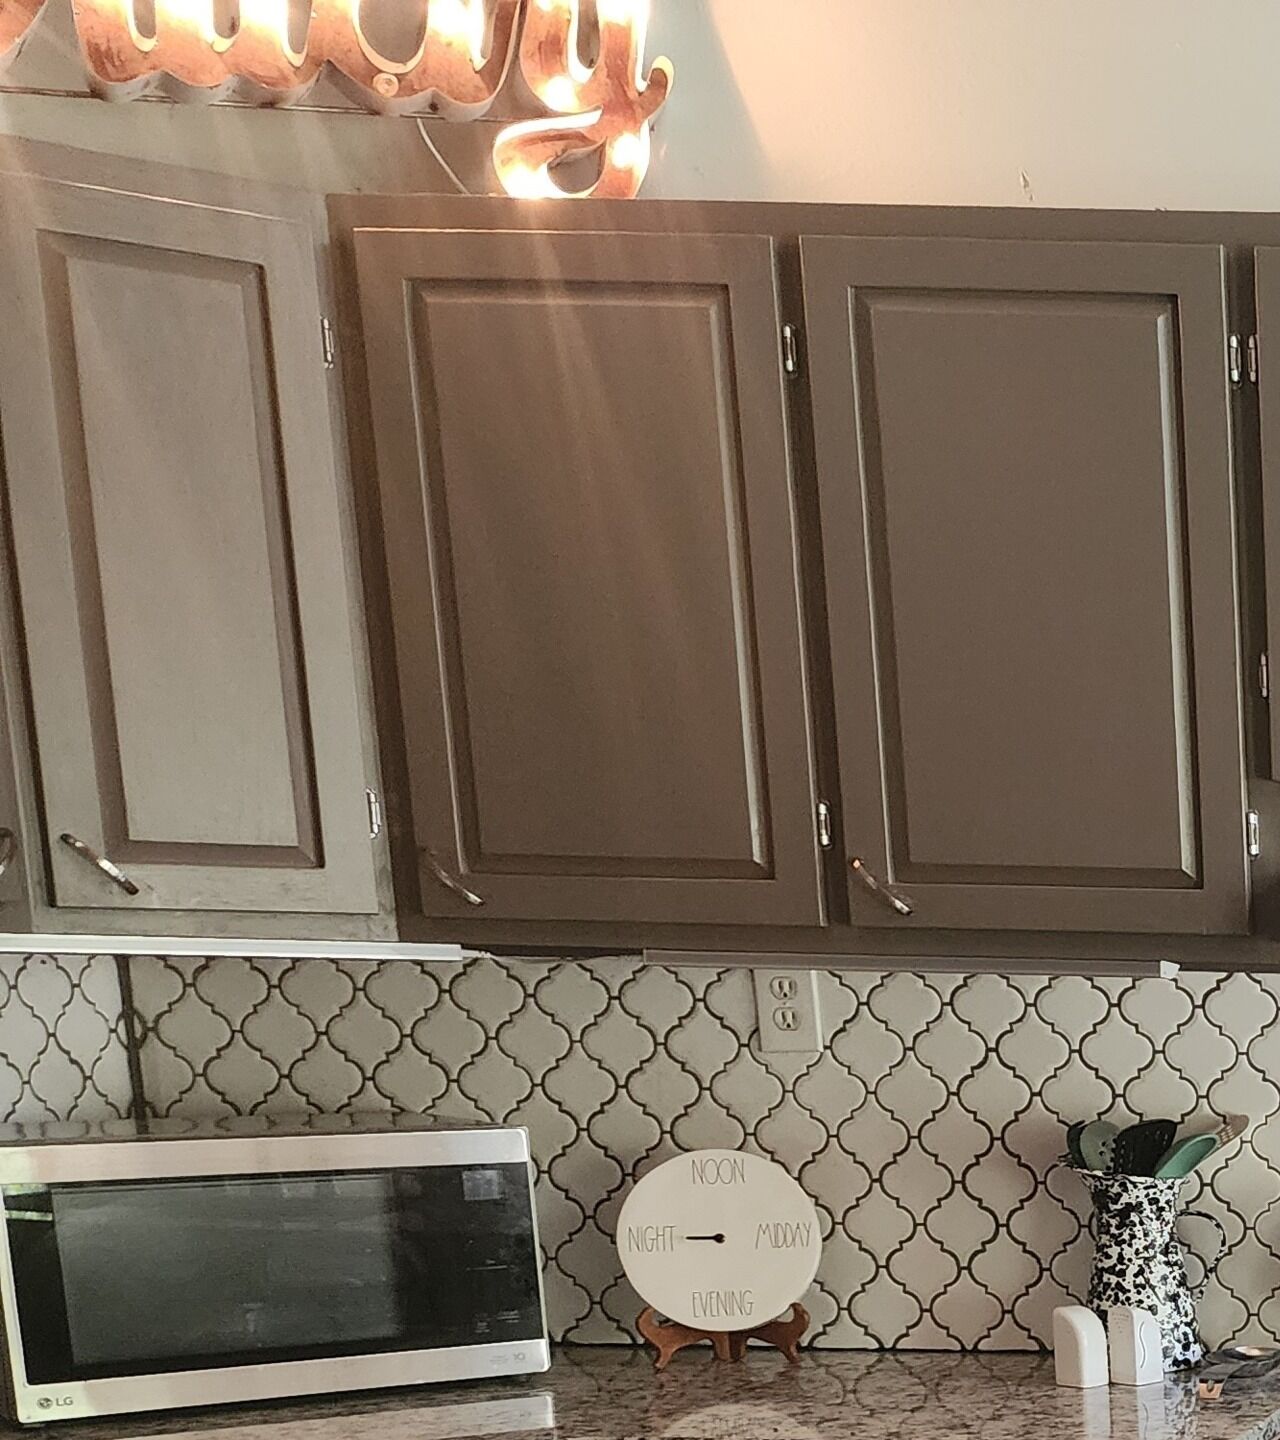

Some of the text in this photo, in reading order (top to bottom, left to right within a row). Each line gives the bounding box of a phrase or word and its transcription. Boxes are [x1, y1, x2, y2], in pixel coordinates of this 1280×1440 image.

[691, 1158, 746, 1185] NOON
[628, 1225, 677, 1253] NIGHT
[756, 1222, 812, 1249] MIDDAY
[692, 1290, 754, 1318] EVENING
[55, 1396, 74, 1407] LG
